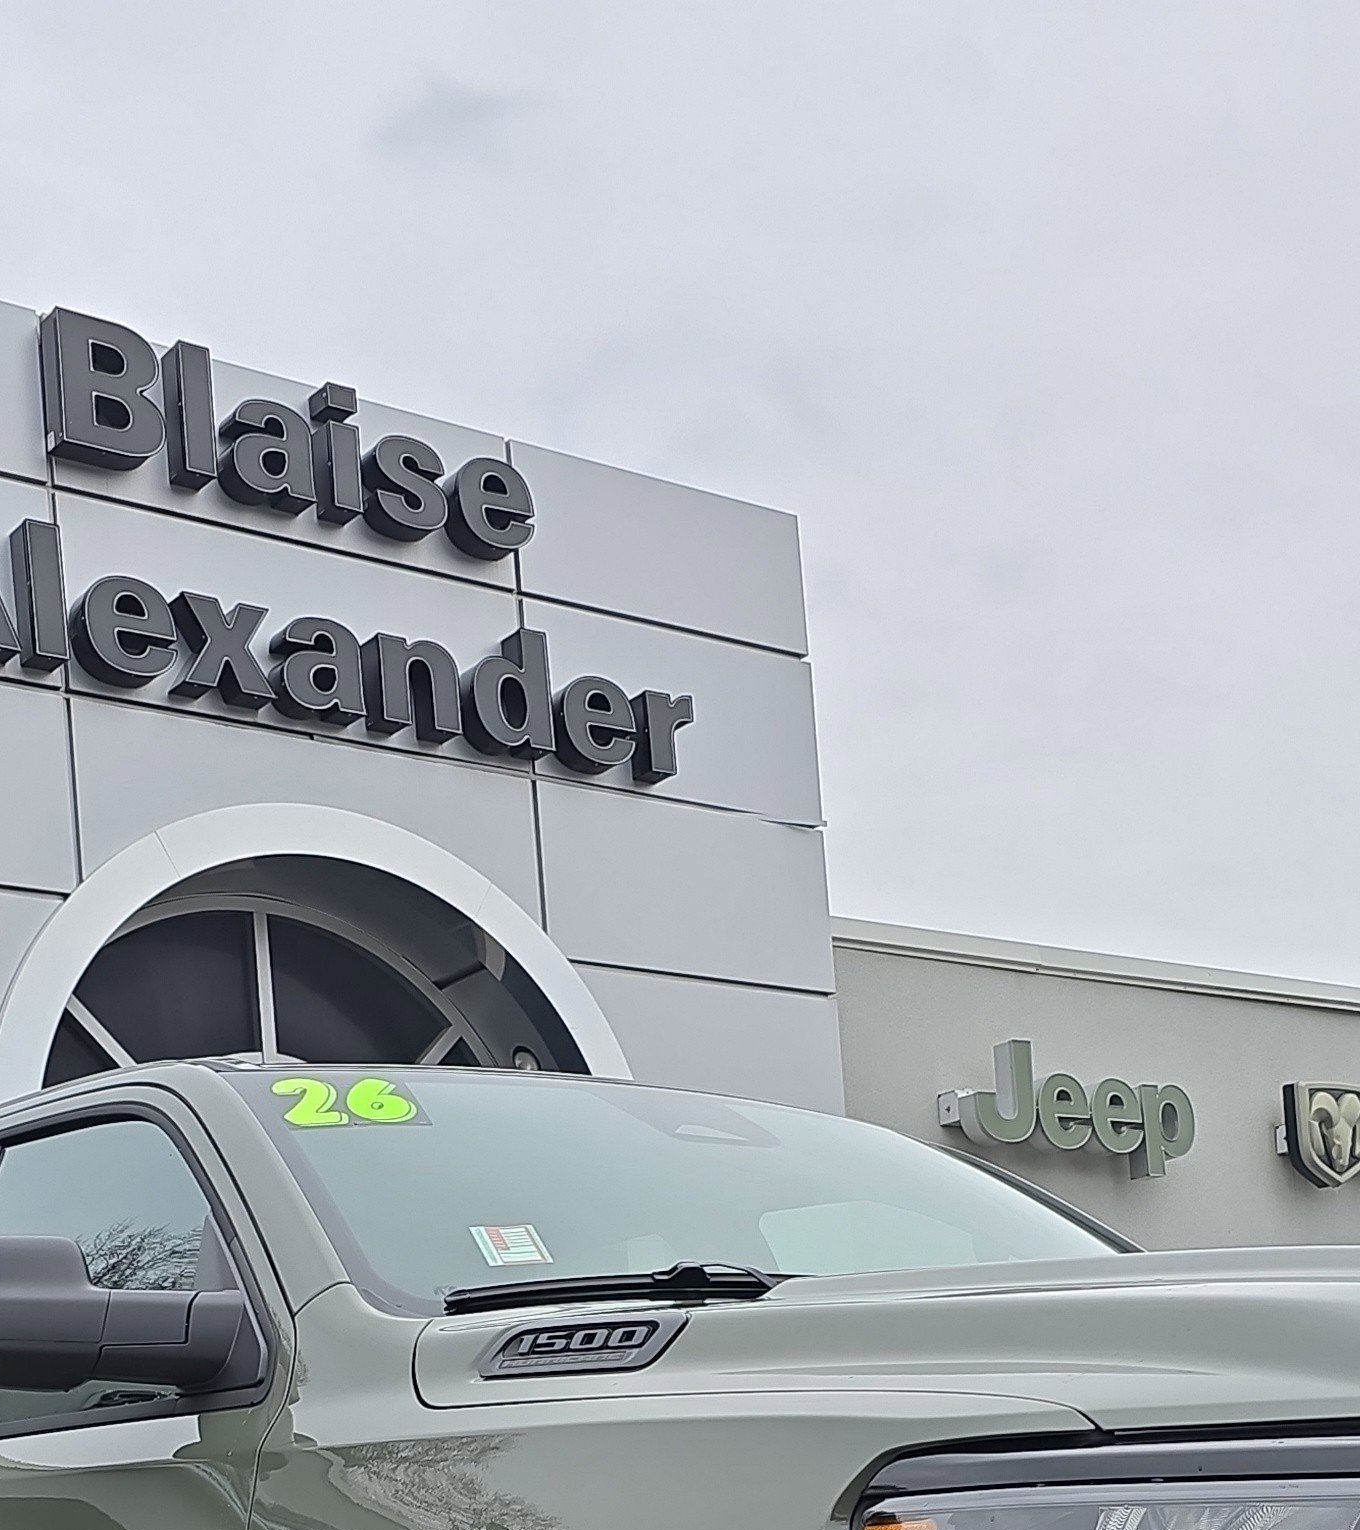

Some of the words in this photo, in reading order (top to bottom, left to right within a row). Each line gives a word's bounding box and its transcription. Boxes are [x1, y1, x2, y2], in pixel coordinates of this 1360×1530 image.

[42, 306, 535, 562] Blaise
[272, 1078, 417, 1126] 26
[960, 1038, 1194, 1179] Jeep
[517, 1325, 650, 1356] 1500
